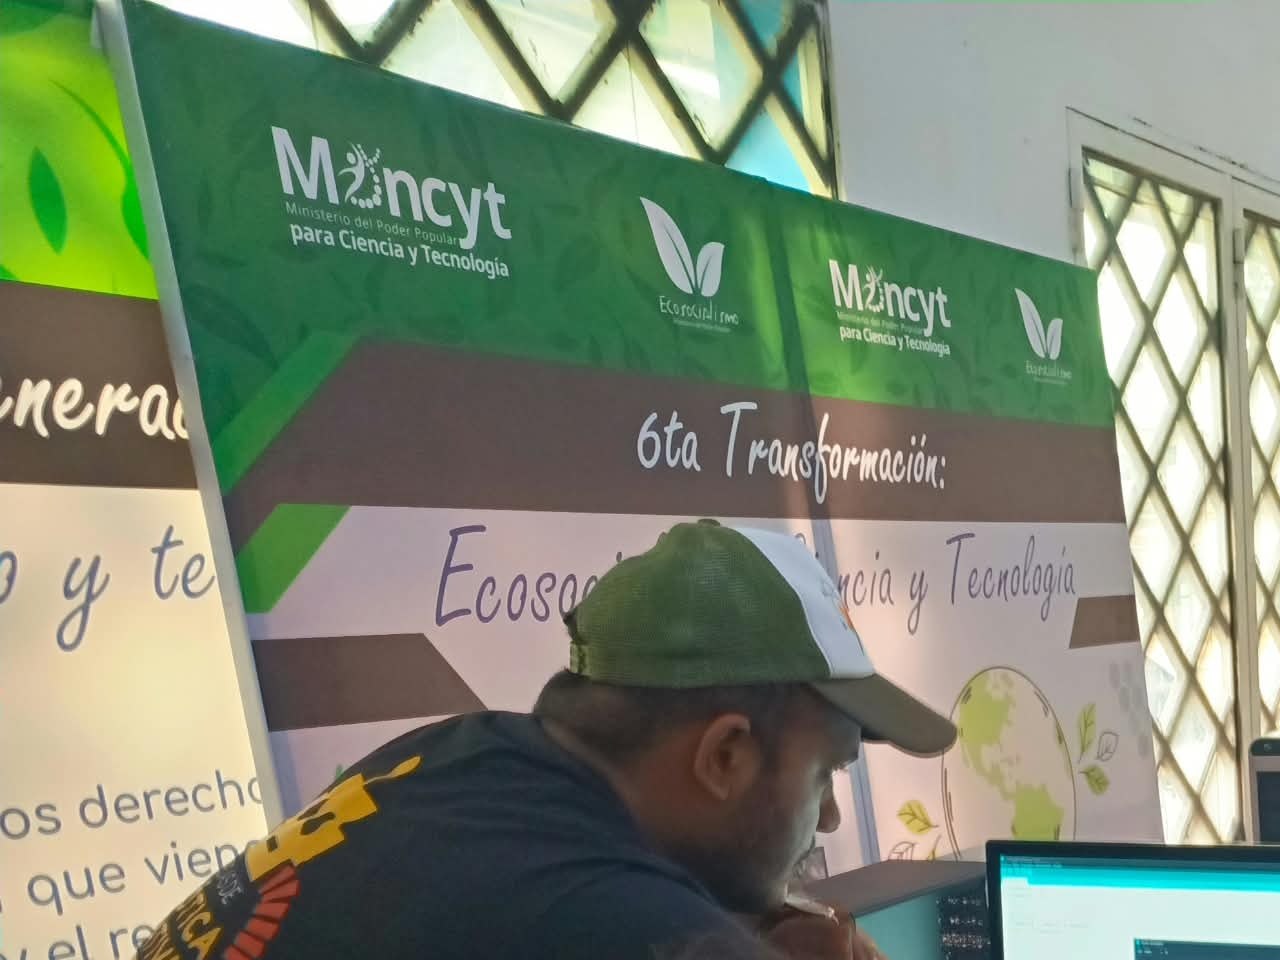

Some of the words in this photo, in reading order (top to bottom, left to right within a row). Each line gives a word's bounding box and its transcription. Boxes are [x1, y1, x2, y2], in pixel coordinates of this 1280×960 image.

[285, 201, 351, 226] Ministerio
[355, 216, 373, 230] del
[377, 220, 410, 237] Poder
[414, 226, 459, 246] Popular
[290, 223, 336, 246] para
[339, 229, 405, 259] Ciencia
[407, 245, 418, 266] y
[419, 244, 510, 279] Tecnología
[840, 326, 862, 342] para
[863, 327, 897, 346] Ciencia
[897, 335, 904, 351] y
[0, 378, 190, 440] nera
[637, 410, 701, 472] 6ta
[719, 401, 946, 505] Transformación:
[56, 554, 111, 652] y
[906, 569, 930, 636] y
[945, 532, 1077, 623] Tecnología
[27, 862, 126, 917] que
[143, 840, 260, 886] vien
